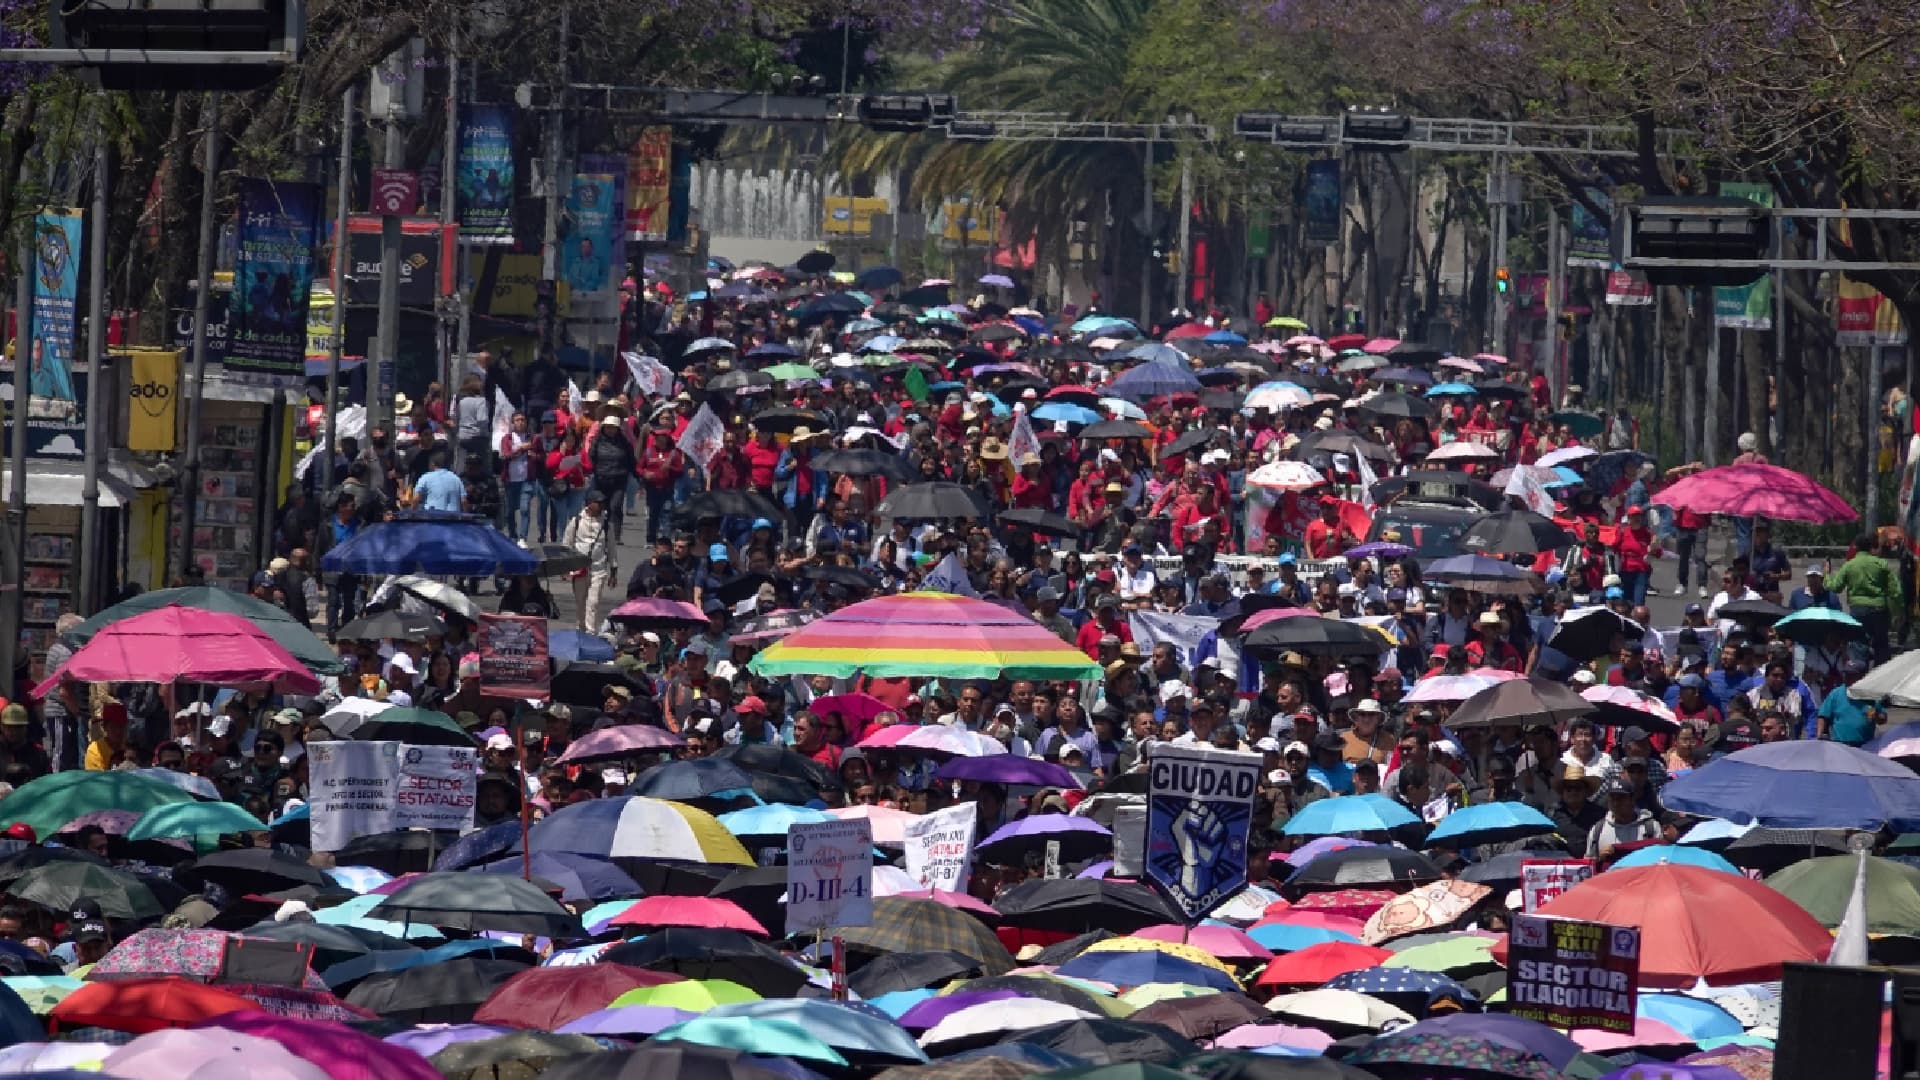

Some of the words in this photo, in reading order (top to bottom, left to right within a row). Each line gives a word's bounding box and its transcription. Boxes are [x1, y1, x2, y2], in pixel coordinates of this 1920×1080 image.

[409, 775, 462, 791] SECTOR
[1152, 763, 1254, 799] CIUDAD
[399, 792, 473, 808] ESTATALES
[1170, 884, 1221, 912] SECTOR
[1518, 960, 1629, 991] SECTOR
[1512, 982, 1631, 1014] TLACOLULA
